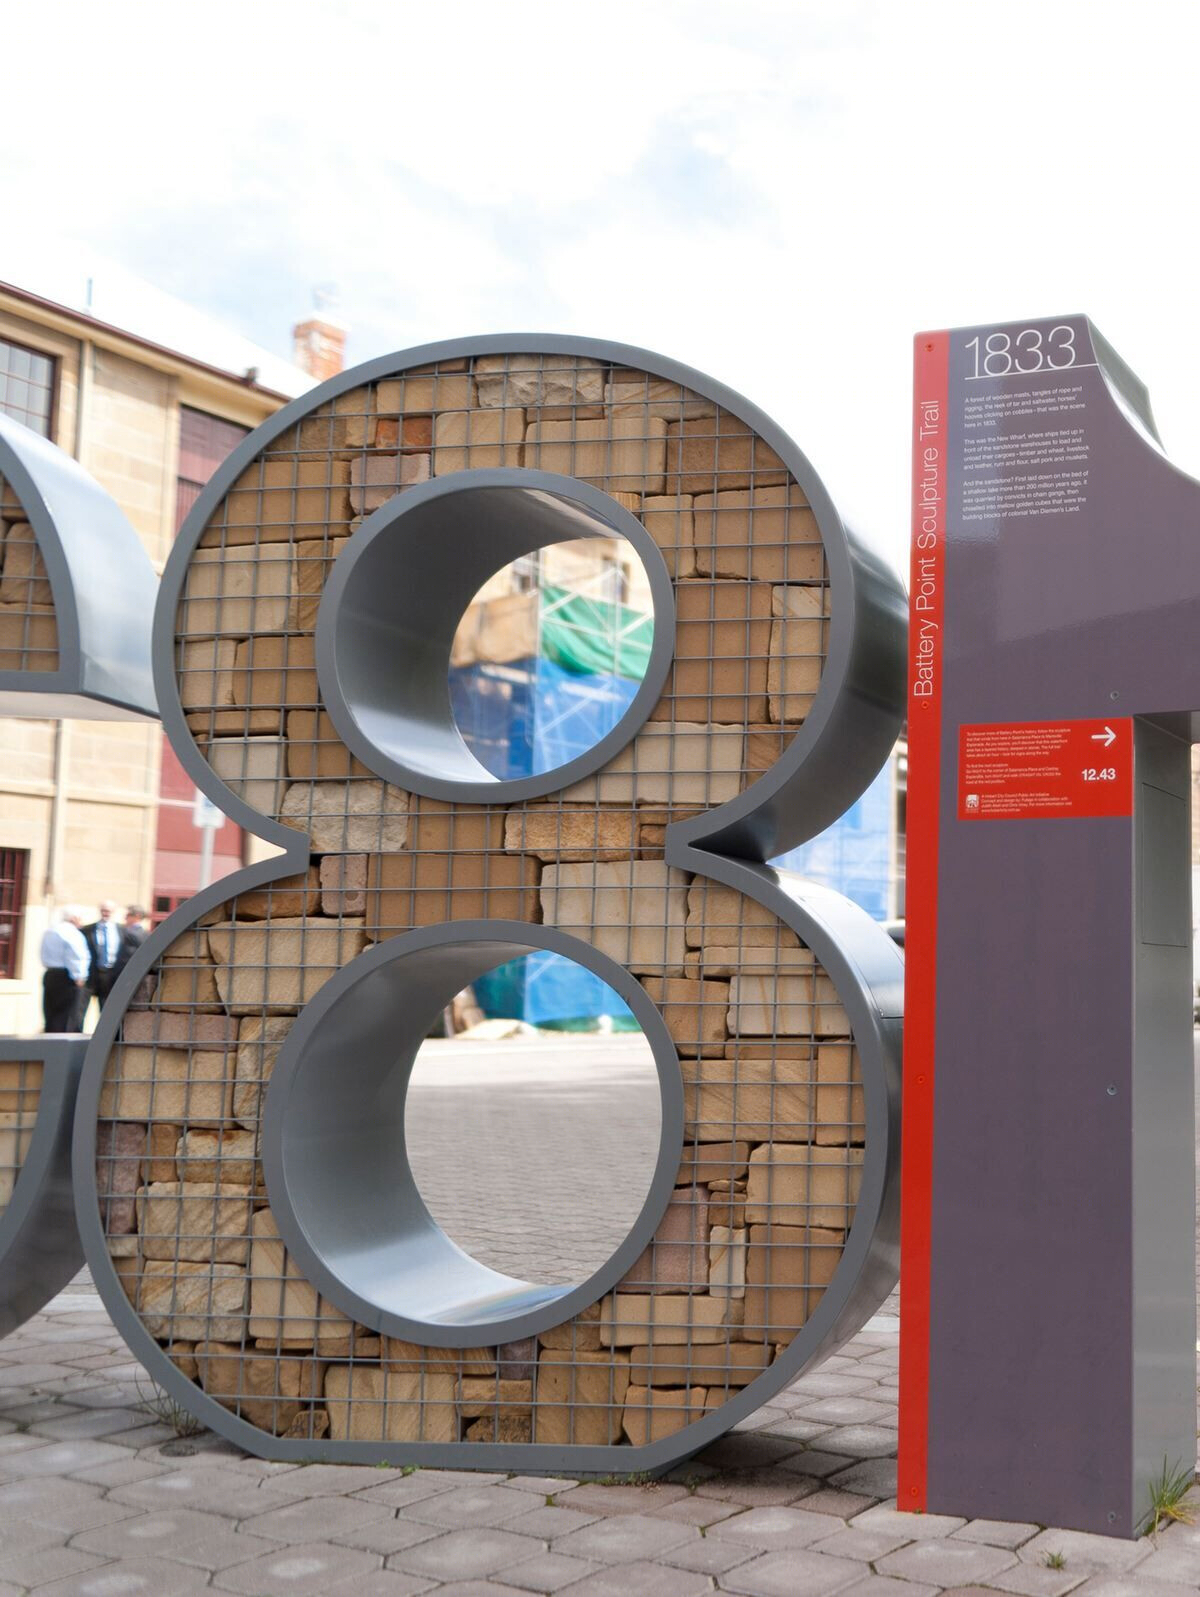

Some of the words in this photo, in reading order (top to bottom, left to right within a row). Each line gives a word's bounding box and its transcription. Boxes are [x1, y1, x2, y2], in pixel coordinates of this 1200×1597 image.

[965, 326, 1075, 378] 1833
[919, 400, 939, 441] Trail
[917, 447, 942, 549] Sculpture
[916, 557, 936, 611] Point
[914, 619, 938, 696] Battery
[1082, 768, 1116, 780] 12.43
